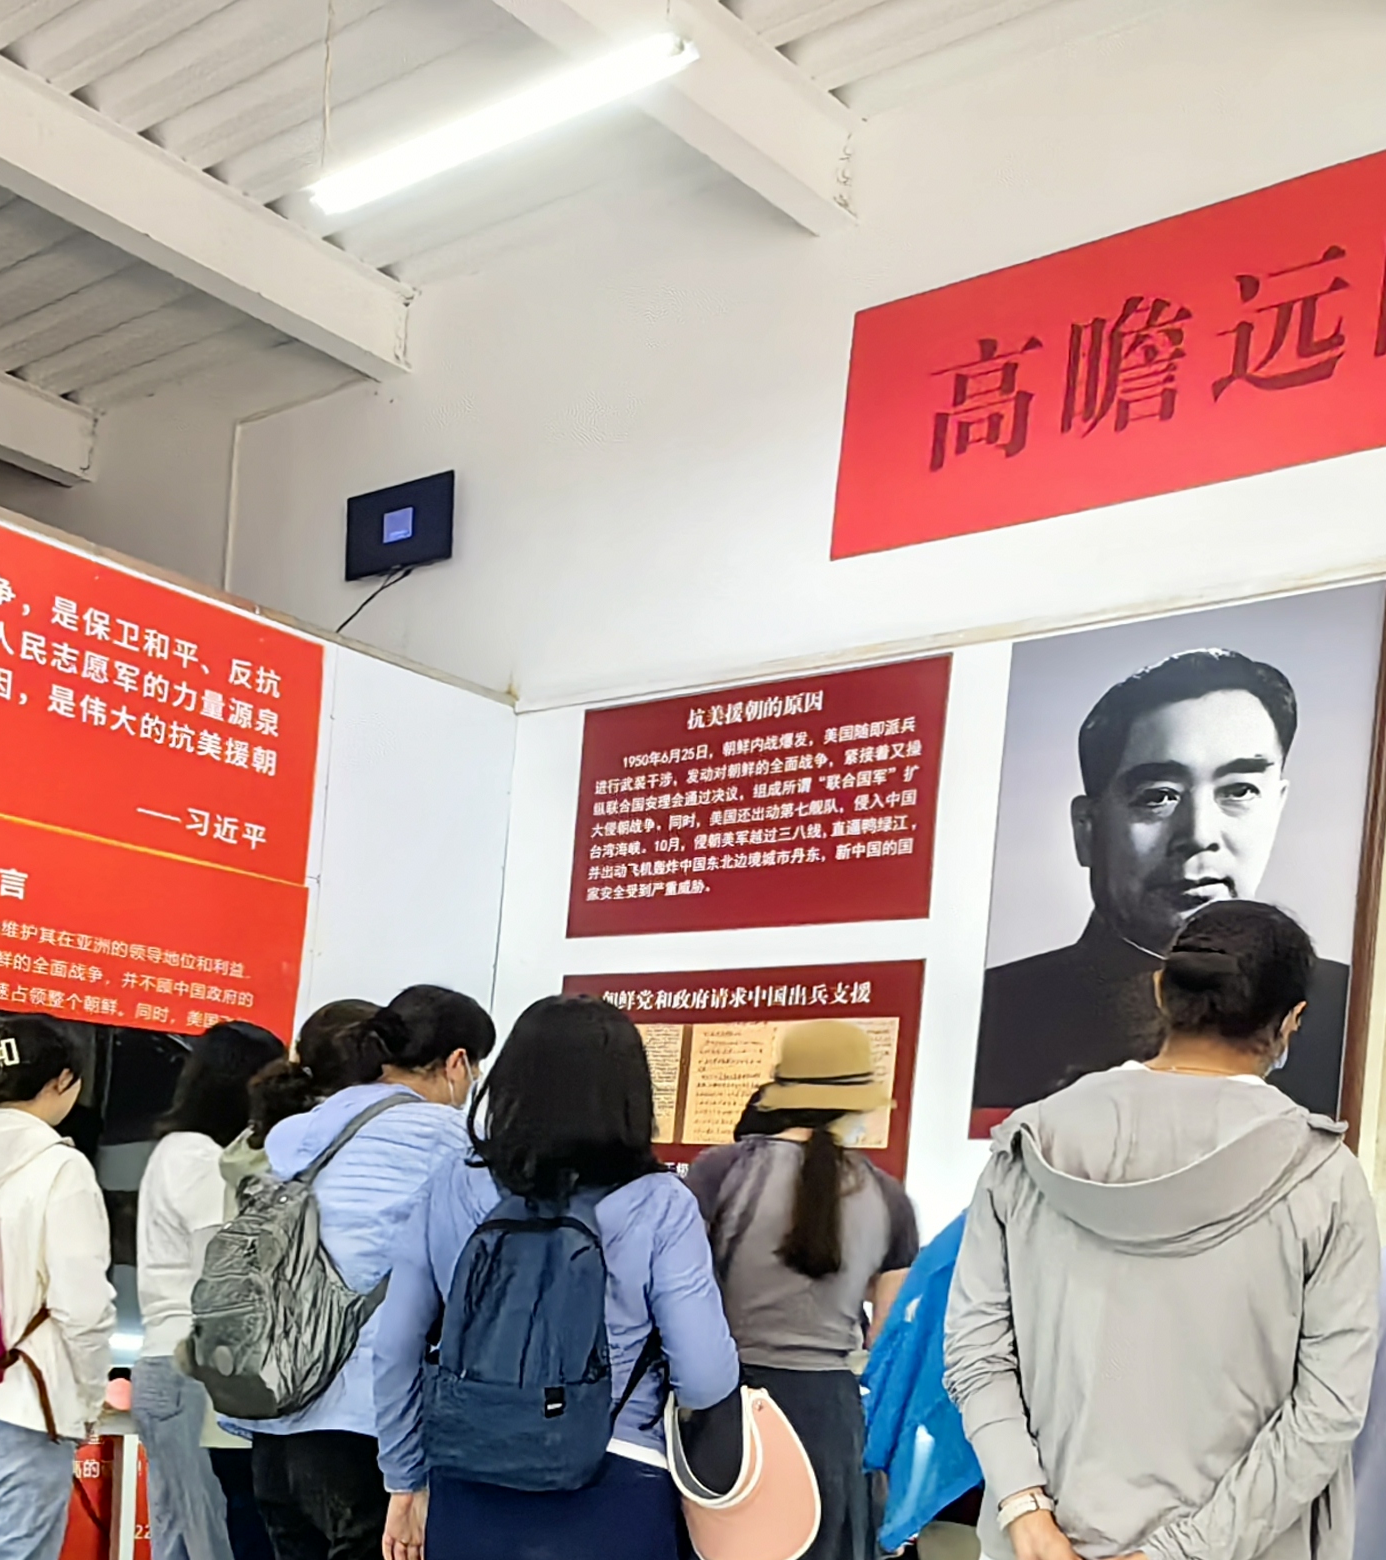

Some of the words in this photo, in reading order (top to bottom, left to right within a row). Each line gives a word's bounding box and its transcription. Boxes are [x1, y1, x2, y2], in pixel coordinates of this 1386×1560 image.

[686, 689, 825, 730] 抗美援朝的原因
